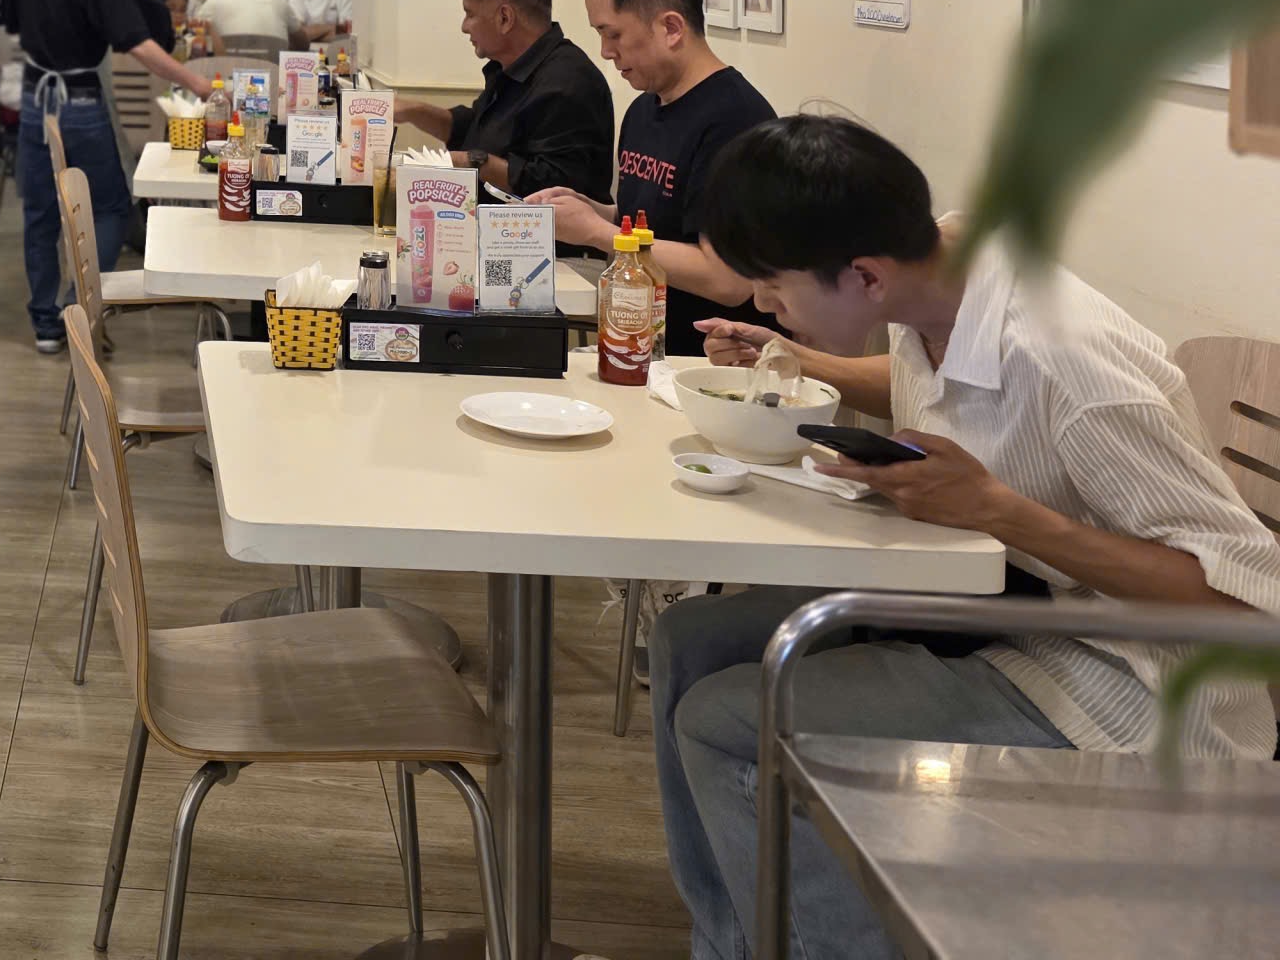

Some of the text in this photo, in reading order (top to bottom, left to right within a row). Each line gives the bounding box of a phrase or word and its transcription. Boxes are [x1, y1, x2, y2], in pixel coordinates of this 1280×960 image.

[349, 105, 386, 115] POPSICLE
[302, 129, 322, 138] Google
[619, 150, 677, 189] DESCENTE
[414, 180, 460, 194] REAL FRUIT
[409, 189, 464, 206] POPSICLE
[501, 229, 533, 239] Google
